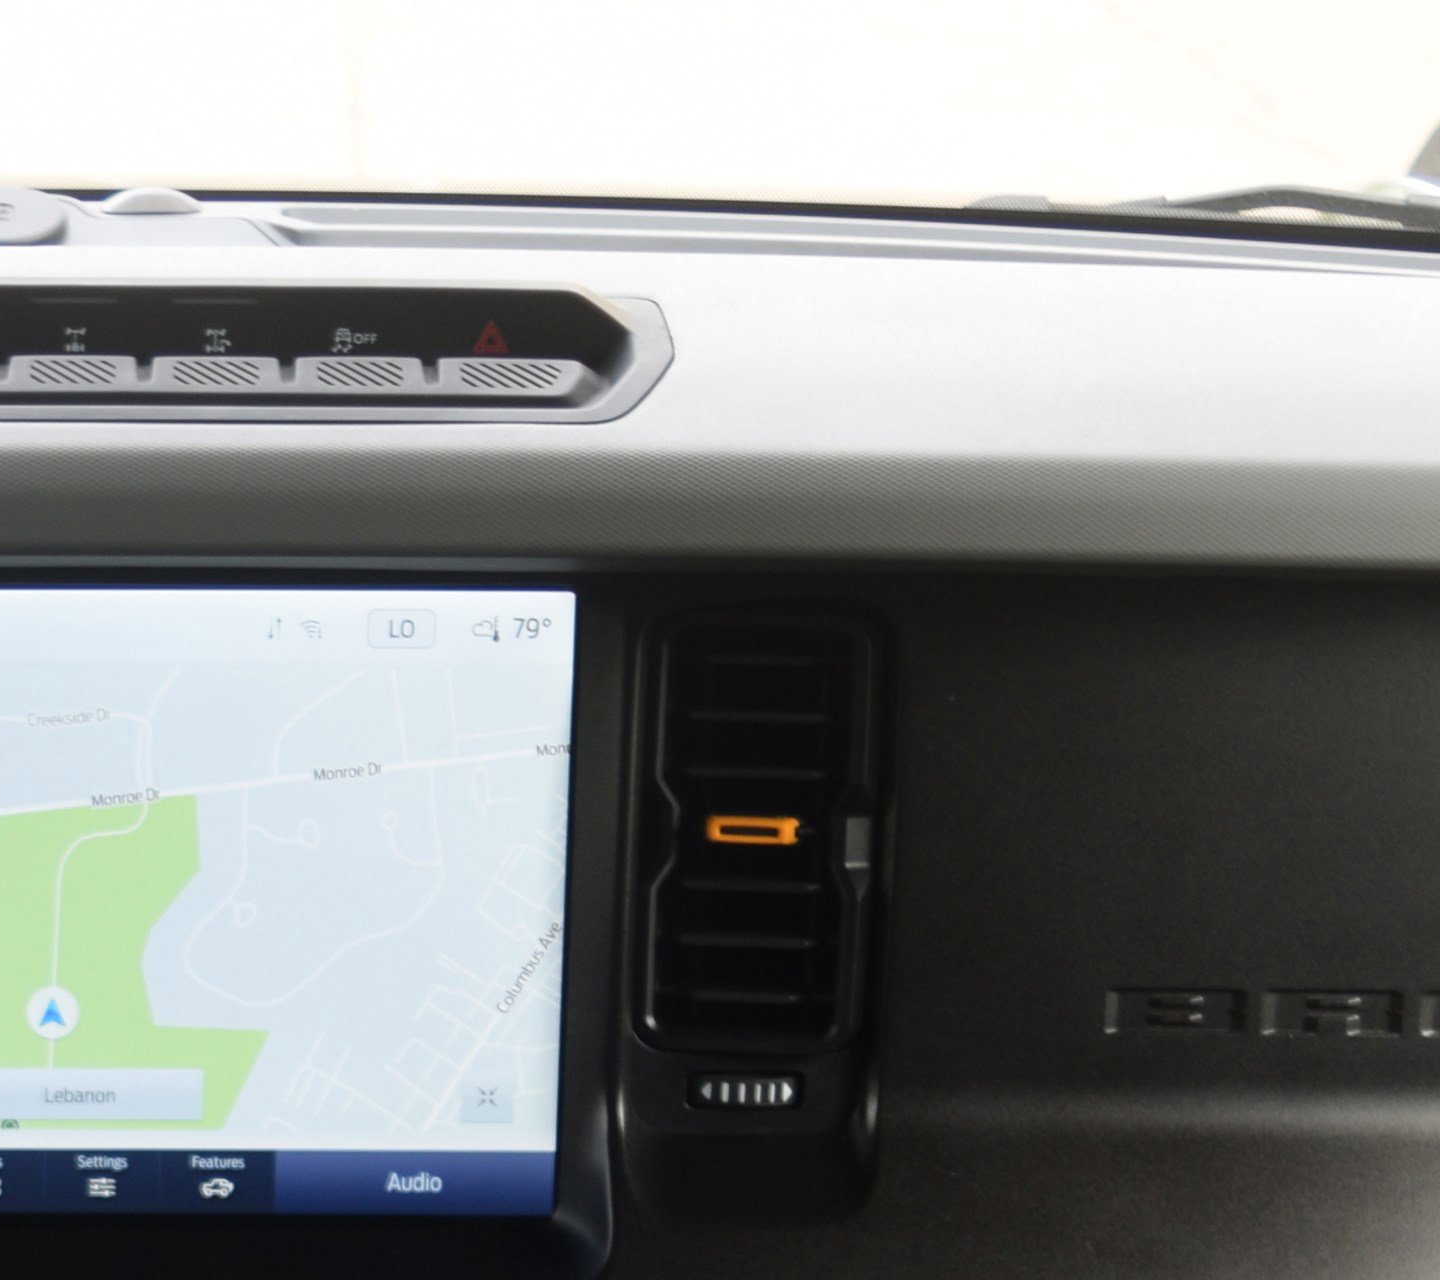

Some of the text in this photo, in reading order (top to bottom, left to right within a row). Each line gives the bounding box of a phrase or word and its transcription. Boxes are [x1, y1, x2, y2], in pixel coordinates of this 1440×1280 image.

[353, 332, 379, 345] OFF
[388, 616, 552, 639] LO 79°
[313, 762, 383, 782] Monroe Dr
[91, 788, 160, 808] Monroe Dr
[496, 922, 562, 1014] Columbus Ave
[43, 1086, 116, 1104] Lebanon
[76, 1154, 128, 1172] Settings
[191, 1154, 245, 1170] Features
[386, 1173, 443, 1193] Audio
